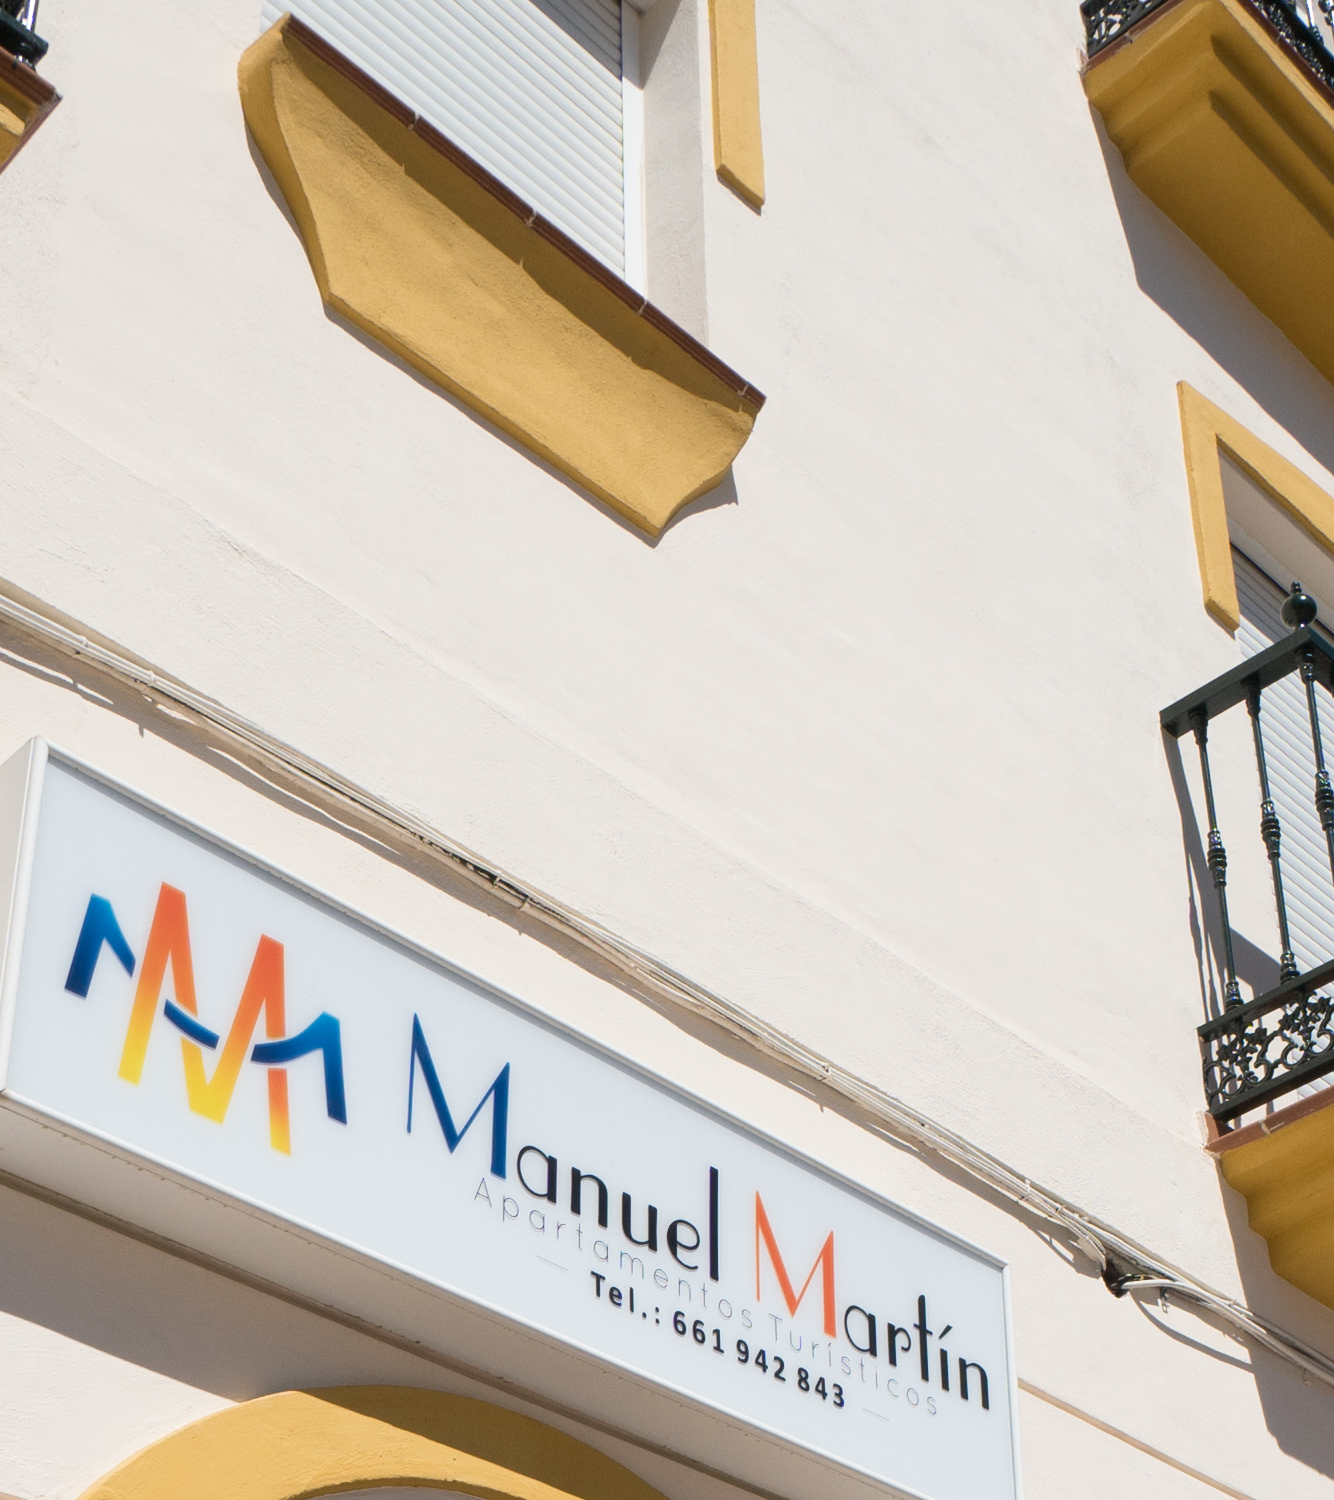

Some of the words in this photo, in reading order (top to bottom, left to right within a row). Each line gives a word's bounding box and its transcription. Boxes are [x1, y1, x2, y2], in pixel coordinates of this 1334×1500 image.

[407, 1012, 719, 1282] Manuel
[755, 1190, 990, 1411] Martín
[473, 1177, 753, 1330] Apartamentos
[769, 1313, 938, 1415] Turísticos
[590, 1270, 661, 1325] Tel.:
[672, 1310, 725, 1355] 661
[735, 1339, 786, 1382] 942
[797, 1367, 845, 1408] 843
